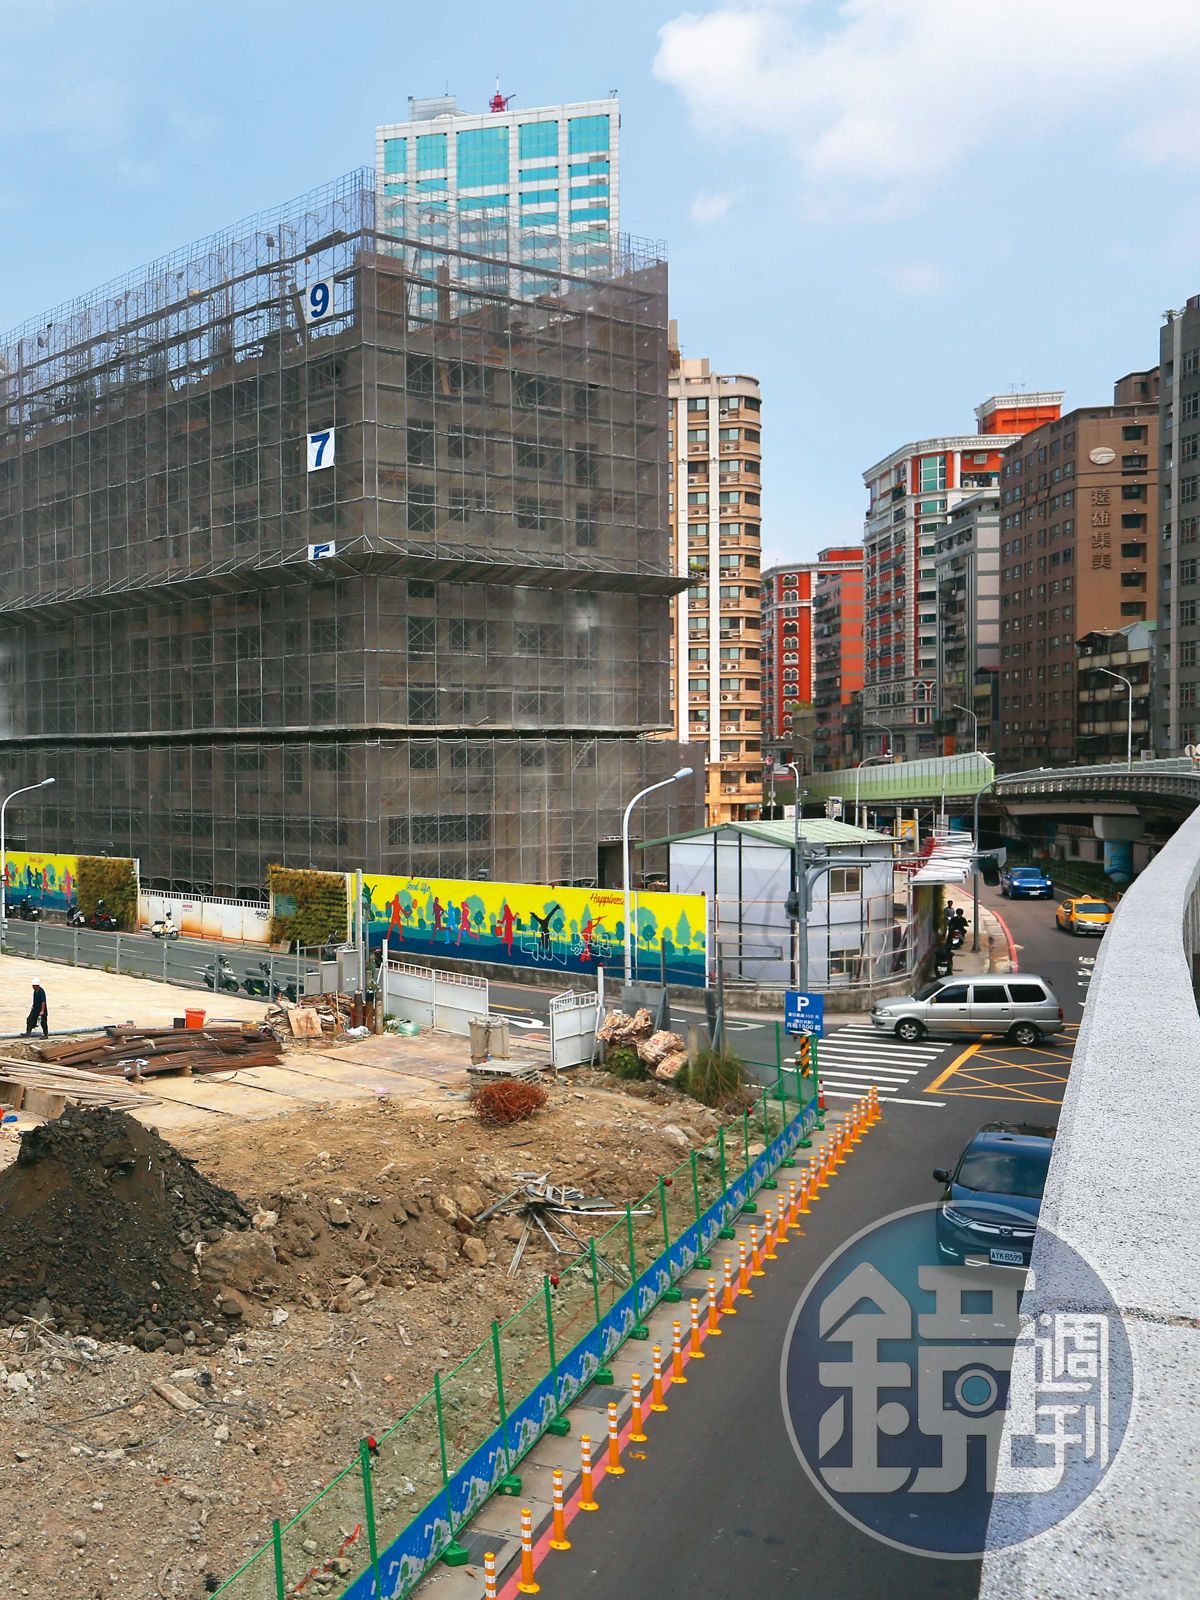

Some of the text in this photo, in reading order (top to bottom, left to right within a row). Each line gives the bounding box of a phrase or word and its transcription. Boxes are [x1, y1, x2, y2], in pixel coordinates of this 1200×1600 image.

[310, 283, 330, 319] 9
[310, 431, 331, 468] 7
[797, 996, 810, 1011] P
